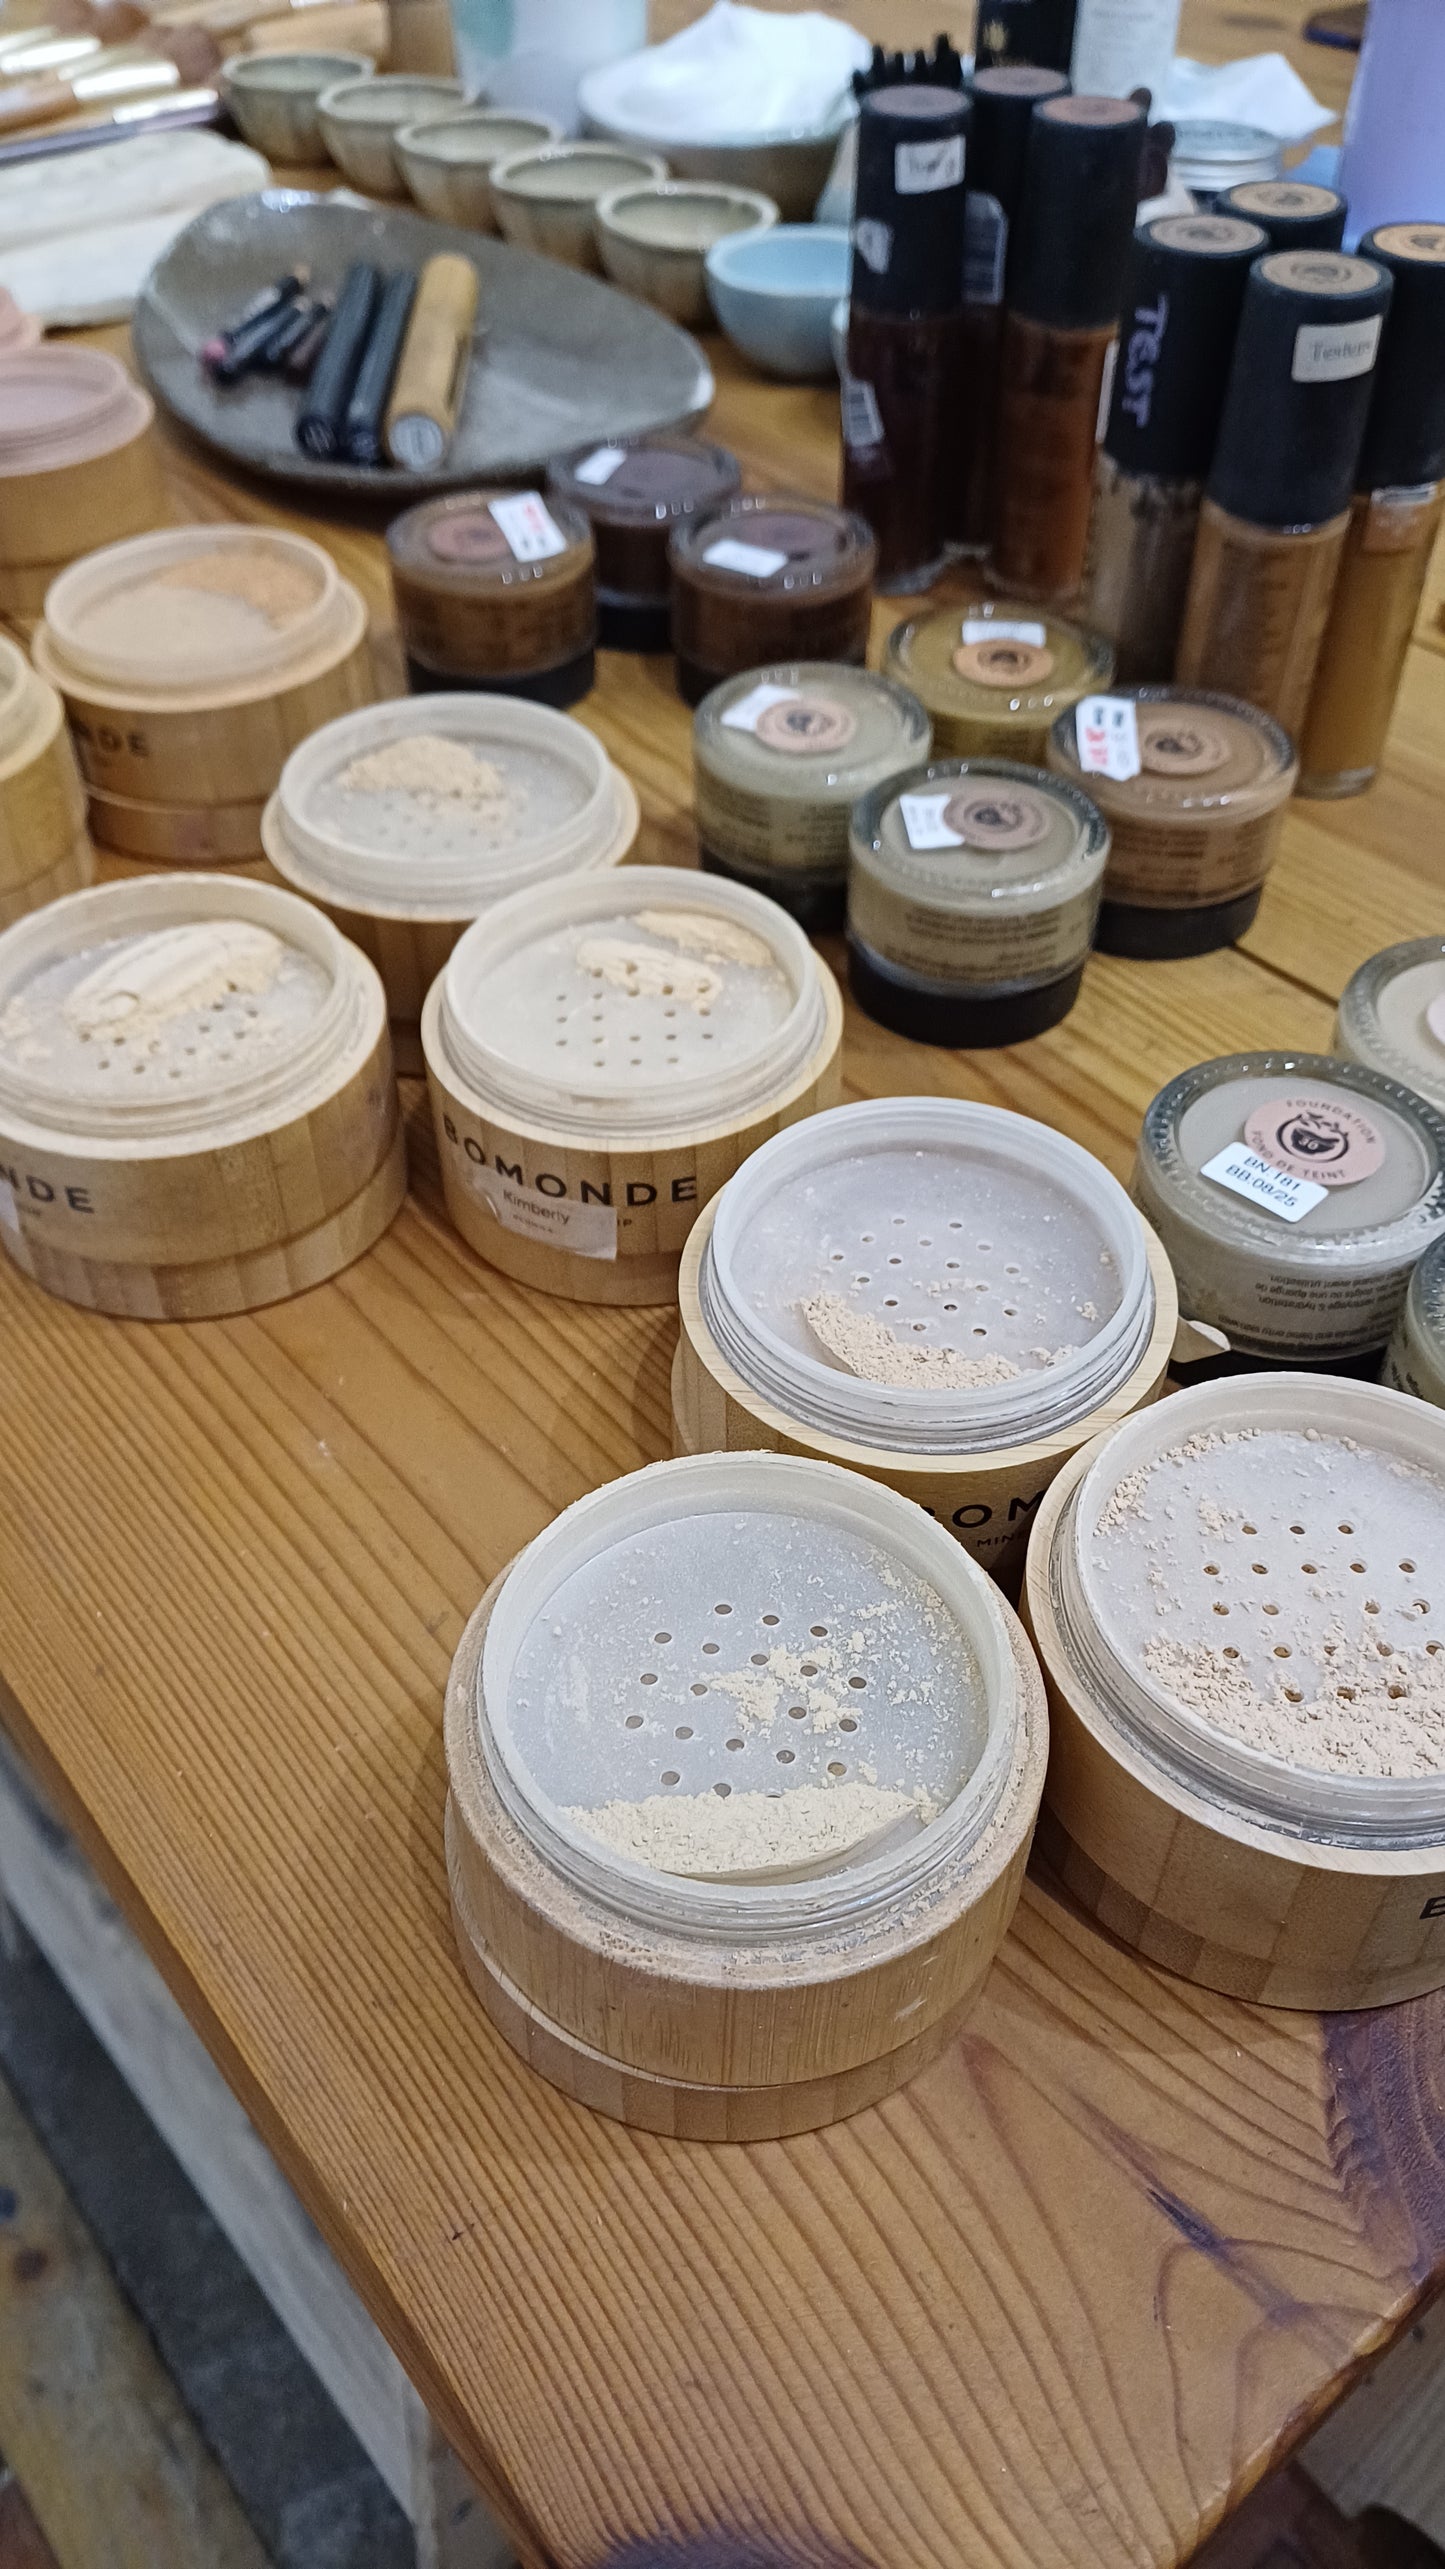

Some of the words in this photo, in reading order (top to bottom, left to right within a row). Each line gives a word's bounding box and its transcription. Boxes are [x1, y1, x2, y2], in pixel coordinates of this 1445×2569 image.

[1286, 1099, 1376, 1144] FOUNDATION
[443, 1113, 698, 1207] BOMONDE
[1252, 1131, 1274, 1159] FOND
[1276, 1160, 1295, 1172] DE
[1303, 1169, 1346, 1179] TEINT
[921, 1489, 1047, 1529] OM
